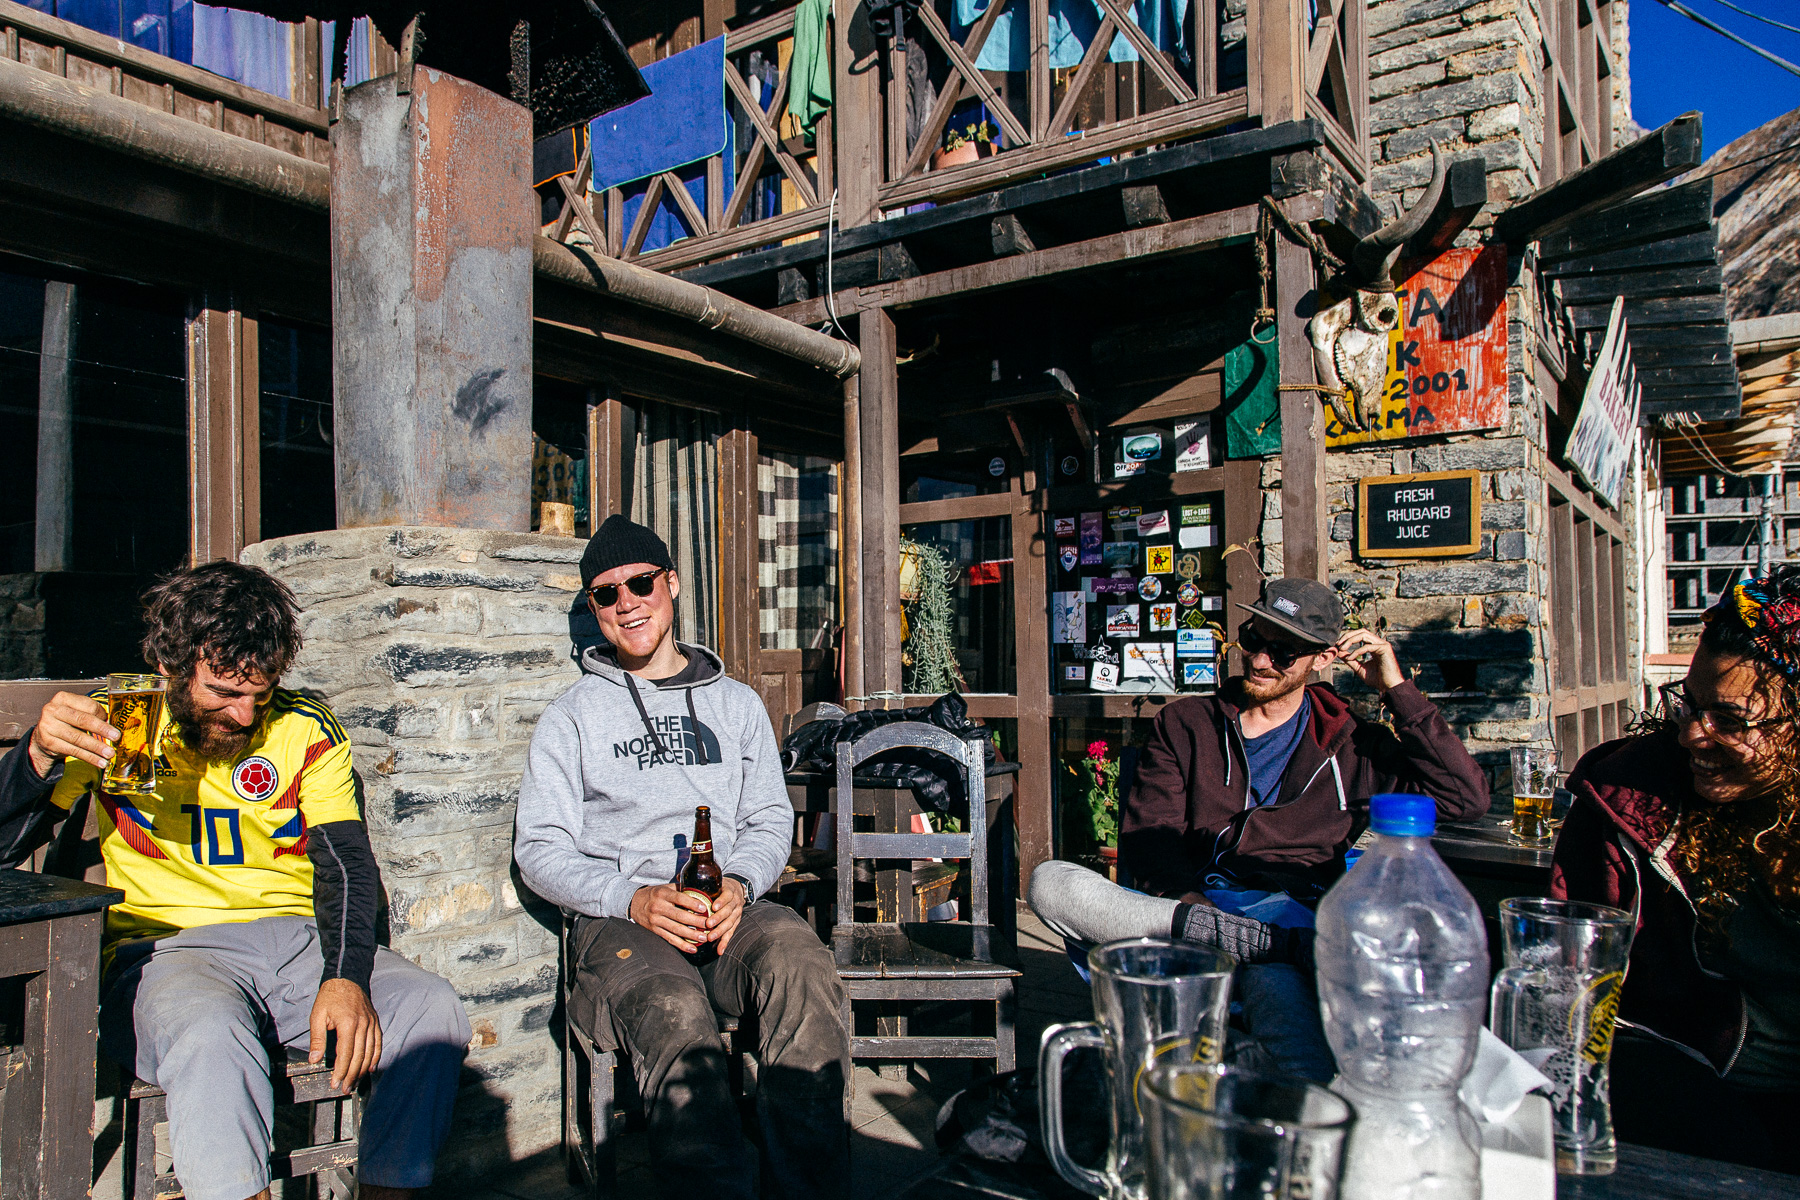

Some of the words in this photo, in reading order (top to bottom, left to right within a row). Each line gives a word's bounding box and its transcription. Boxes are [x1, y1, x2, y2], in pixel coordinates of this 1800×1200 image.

[1599, 367, 1632, 446] BAKERY
[1325, 404, 1437, 439] KRMA
[1394, 487, 1434, 504] FRESH
[1387, 505, 1451, 522] RHUBARB
[1396, 525, 1430, 539] JUICE
[115, 698, 136, 732] BORG
[637, 749, 685, 771] FACE
[180, 803, 245, 866] 10
